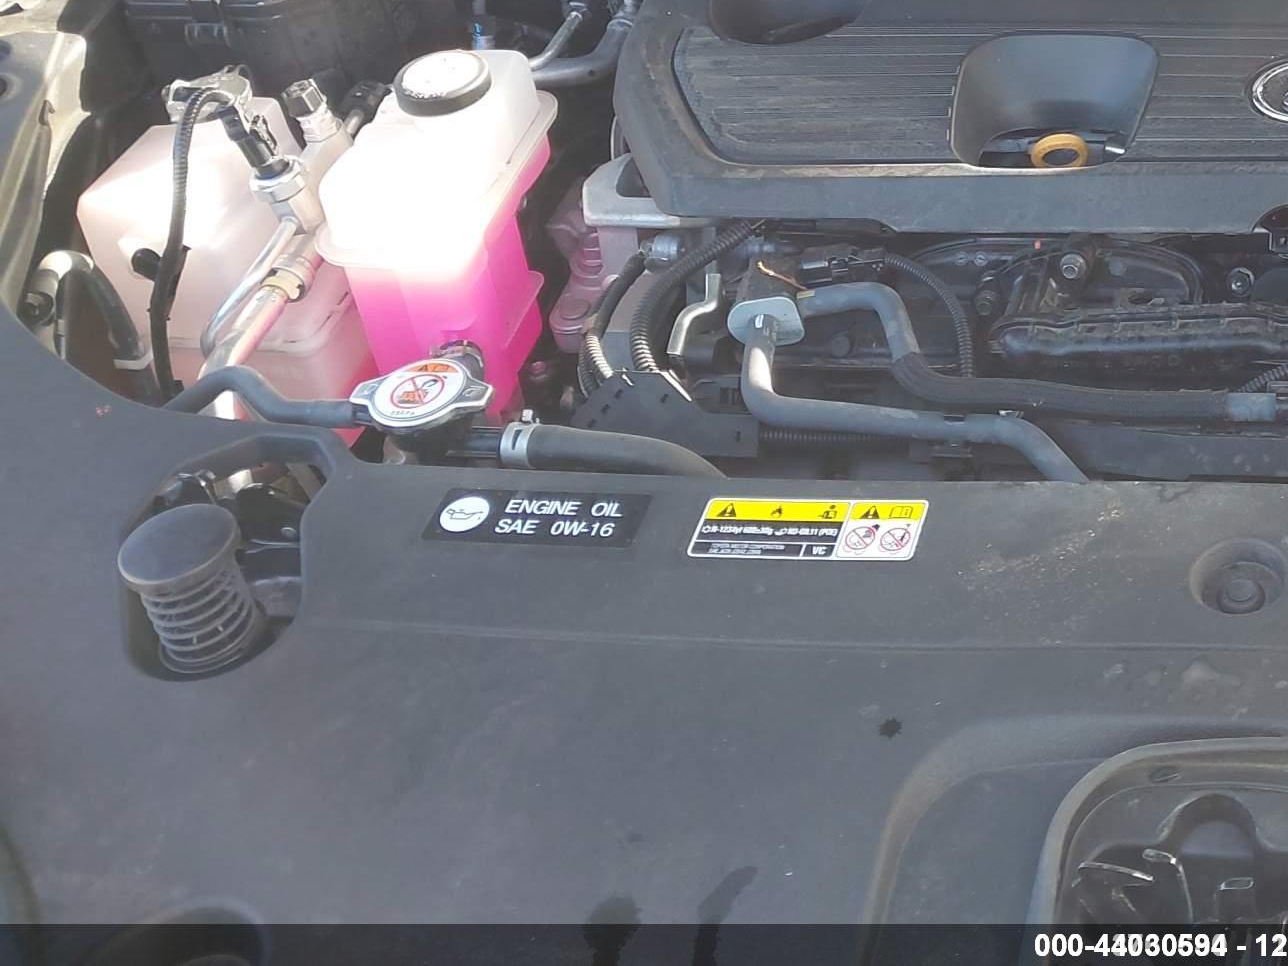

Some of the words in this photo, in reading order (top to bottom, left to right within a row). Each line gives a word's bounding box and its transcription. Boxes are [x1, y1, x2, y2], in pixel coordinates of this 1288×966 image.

[504, 499, 582, 516] ENGINE
[590, 501, 623, 517] OIL
[494, 518, 541, 535] SAE
[550, 520, 616, 537] 0W-16
[811, 546, 828, 556] VC
